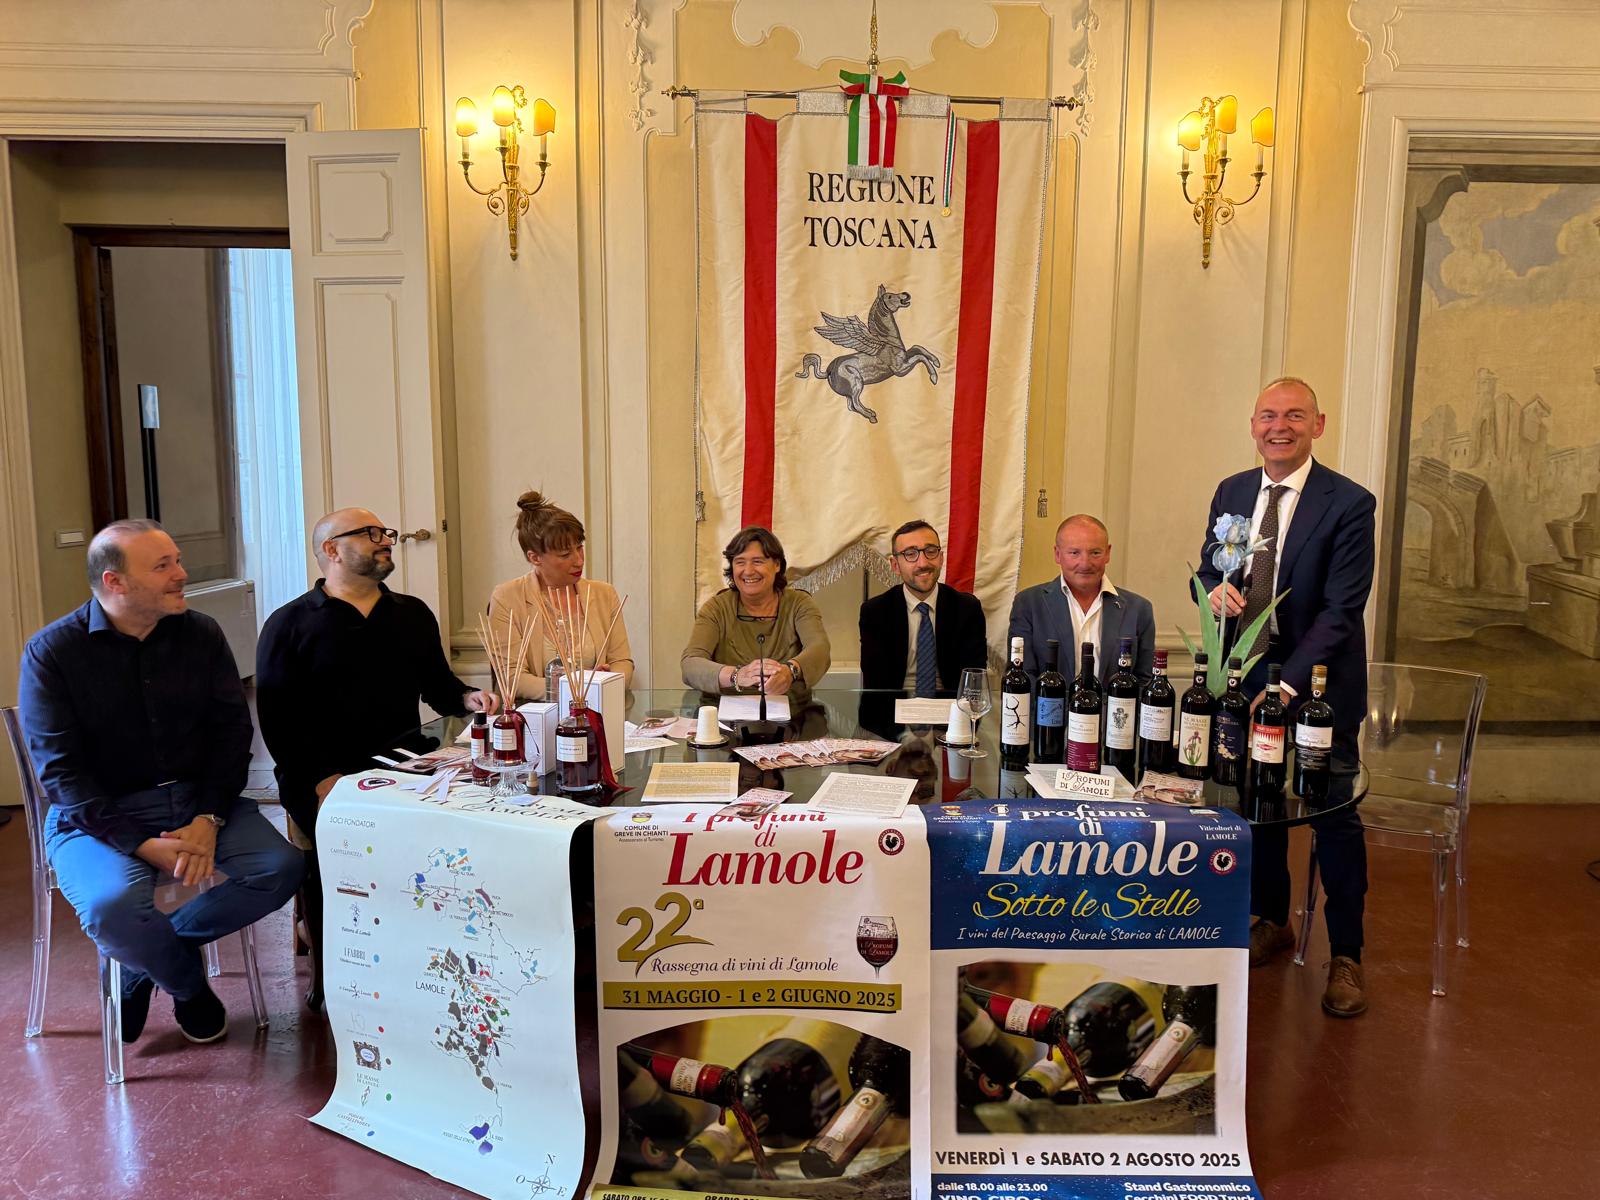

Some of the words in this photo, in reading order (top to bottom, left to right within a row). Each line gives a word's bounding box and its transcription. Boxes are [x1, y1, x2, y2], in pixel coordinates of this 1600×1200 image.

[808, 172, 935, 205] REGIONE
[803, 216, 937, 249] TOSCANA
[1065, 771, 1110, 787] PROFUMI
[1069, 782, 1110, 796] LAMOLE
[682, 812, 698, 823] I
[1019, 804, 1150, 821] profumi
[344, 818, 376, 828] FONDATORI
[1079, 816, 1104, 836] di
[755, 823, 778, 848] di
[979, 820, 1199, 877] Lamole
[662, 829, 864, 886] Lamole
[973, 882, 1067, 920] Sotto
[1071, 889, 1098, 918] le
[1101, 882, 1201, 921] Stelle
[956, 928, 965, 939] I
[968, 928, 988, 939] vini
[991, 928, 1008, 939] del
[1010, 928, 1066, 942] Paesaggio
[1069, 928, 1106, 941] Rurale
[1110, 927, 1150, 941] Storico
[1154, 928, 1166, 939] di
[1168, 927, 1221, 940] LAMOLE
[651, 957, 717, 976] Rassegna
[722, 957, 736, 971] di
[740, 958, 765, 971] vini
[769, 957, 783, 970] di
[787, 957, 839, 972] Lamole
[415, 980, 446, 995] LAMOLE
[622, 990, 640, 1004] 31
[647, 989, 721, 1003] MAGGIO
[739, 989, 746, 1002] 1
[752, 992, 761, 1002] e
[767, 989, 776, 1002] 2
[781, 989, 851, 1004] GIUGNO
[856, 991, 896, 1007] 2025
[544, 1153, 556, 1165] N
[935, 1147, 1005, 1165] VENERDÌ
[1012, 1152, 1018, 1165] 1
[1026, 1155, 1035, 1165] e
[1040, 1152, 1105, 1165] SABATO
[1110, 1152, 1120, 1166] 2
[1125, 1152, 1195, 1167] AGOSTO
[1199, 1153, 1241, 1167] 2025
[515, 1174, 526, 1184] O
[937, 1182, 964, 1191] dalle
[965, 1182, 994, 1191] 18.00
[996, 1182, 1015, 1191] alle
[1017, 1183, 1048, 1191] 23.00
[1124, 1182, 1161, 1192] Stand
[1162, 1182, 1251, 1192] Gastronomico
[556, 1186, 567, 1197] E
